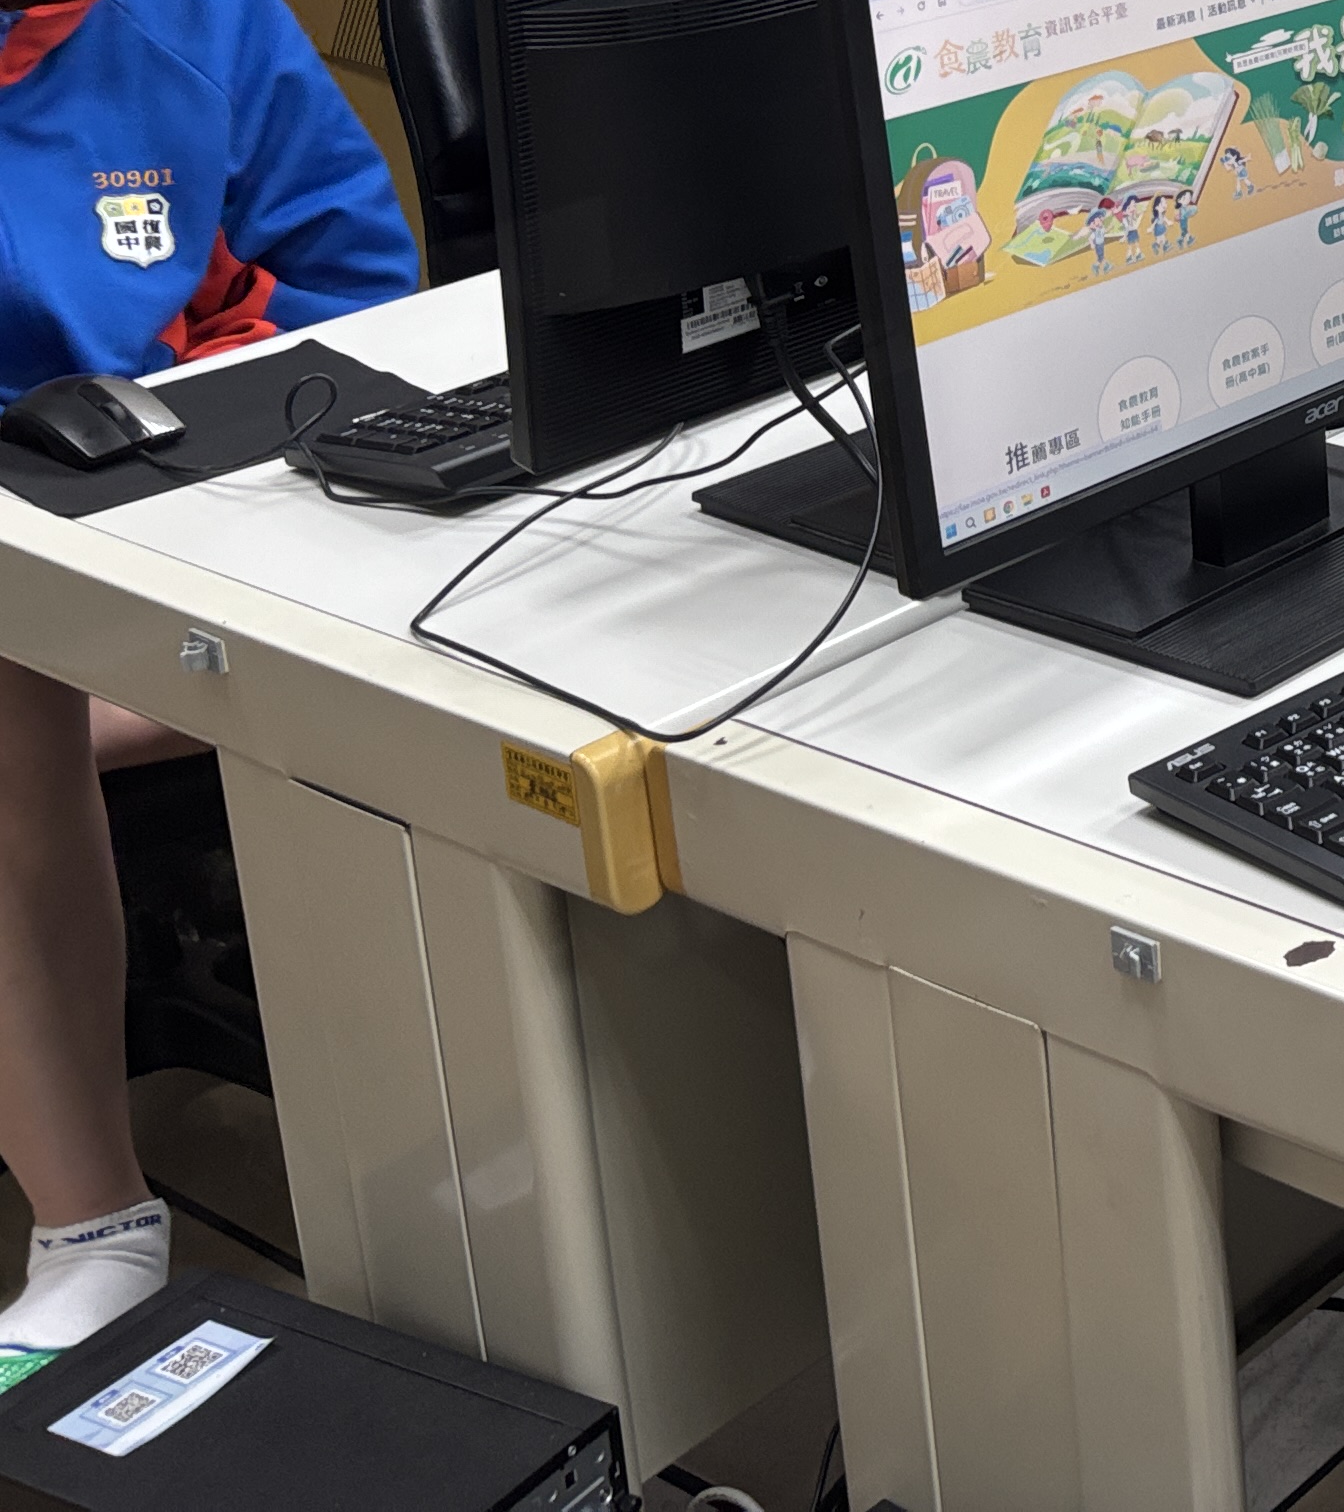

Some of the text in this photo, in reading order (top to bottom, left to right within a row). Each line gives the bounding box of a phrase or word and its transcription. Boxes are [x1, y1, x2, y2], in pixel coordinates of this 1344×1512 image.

[1155, 9, 1196, 31] 最新消息
[933, 1, 1129, 79] 食農教育 資訊整合平臺
[92, 168, 176, 190] 30901
[1117, 386, 1160, 413] 食農教育
[1119, 403, 1162, 431] 知能手冊
[1005, 427, 1082, 476] 推薦專區
[1166, 741, 1216, 771] ASUS
[60, 1213, 162, 1244] VICTOR
